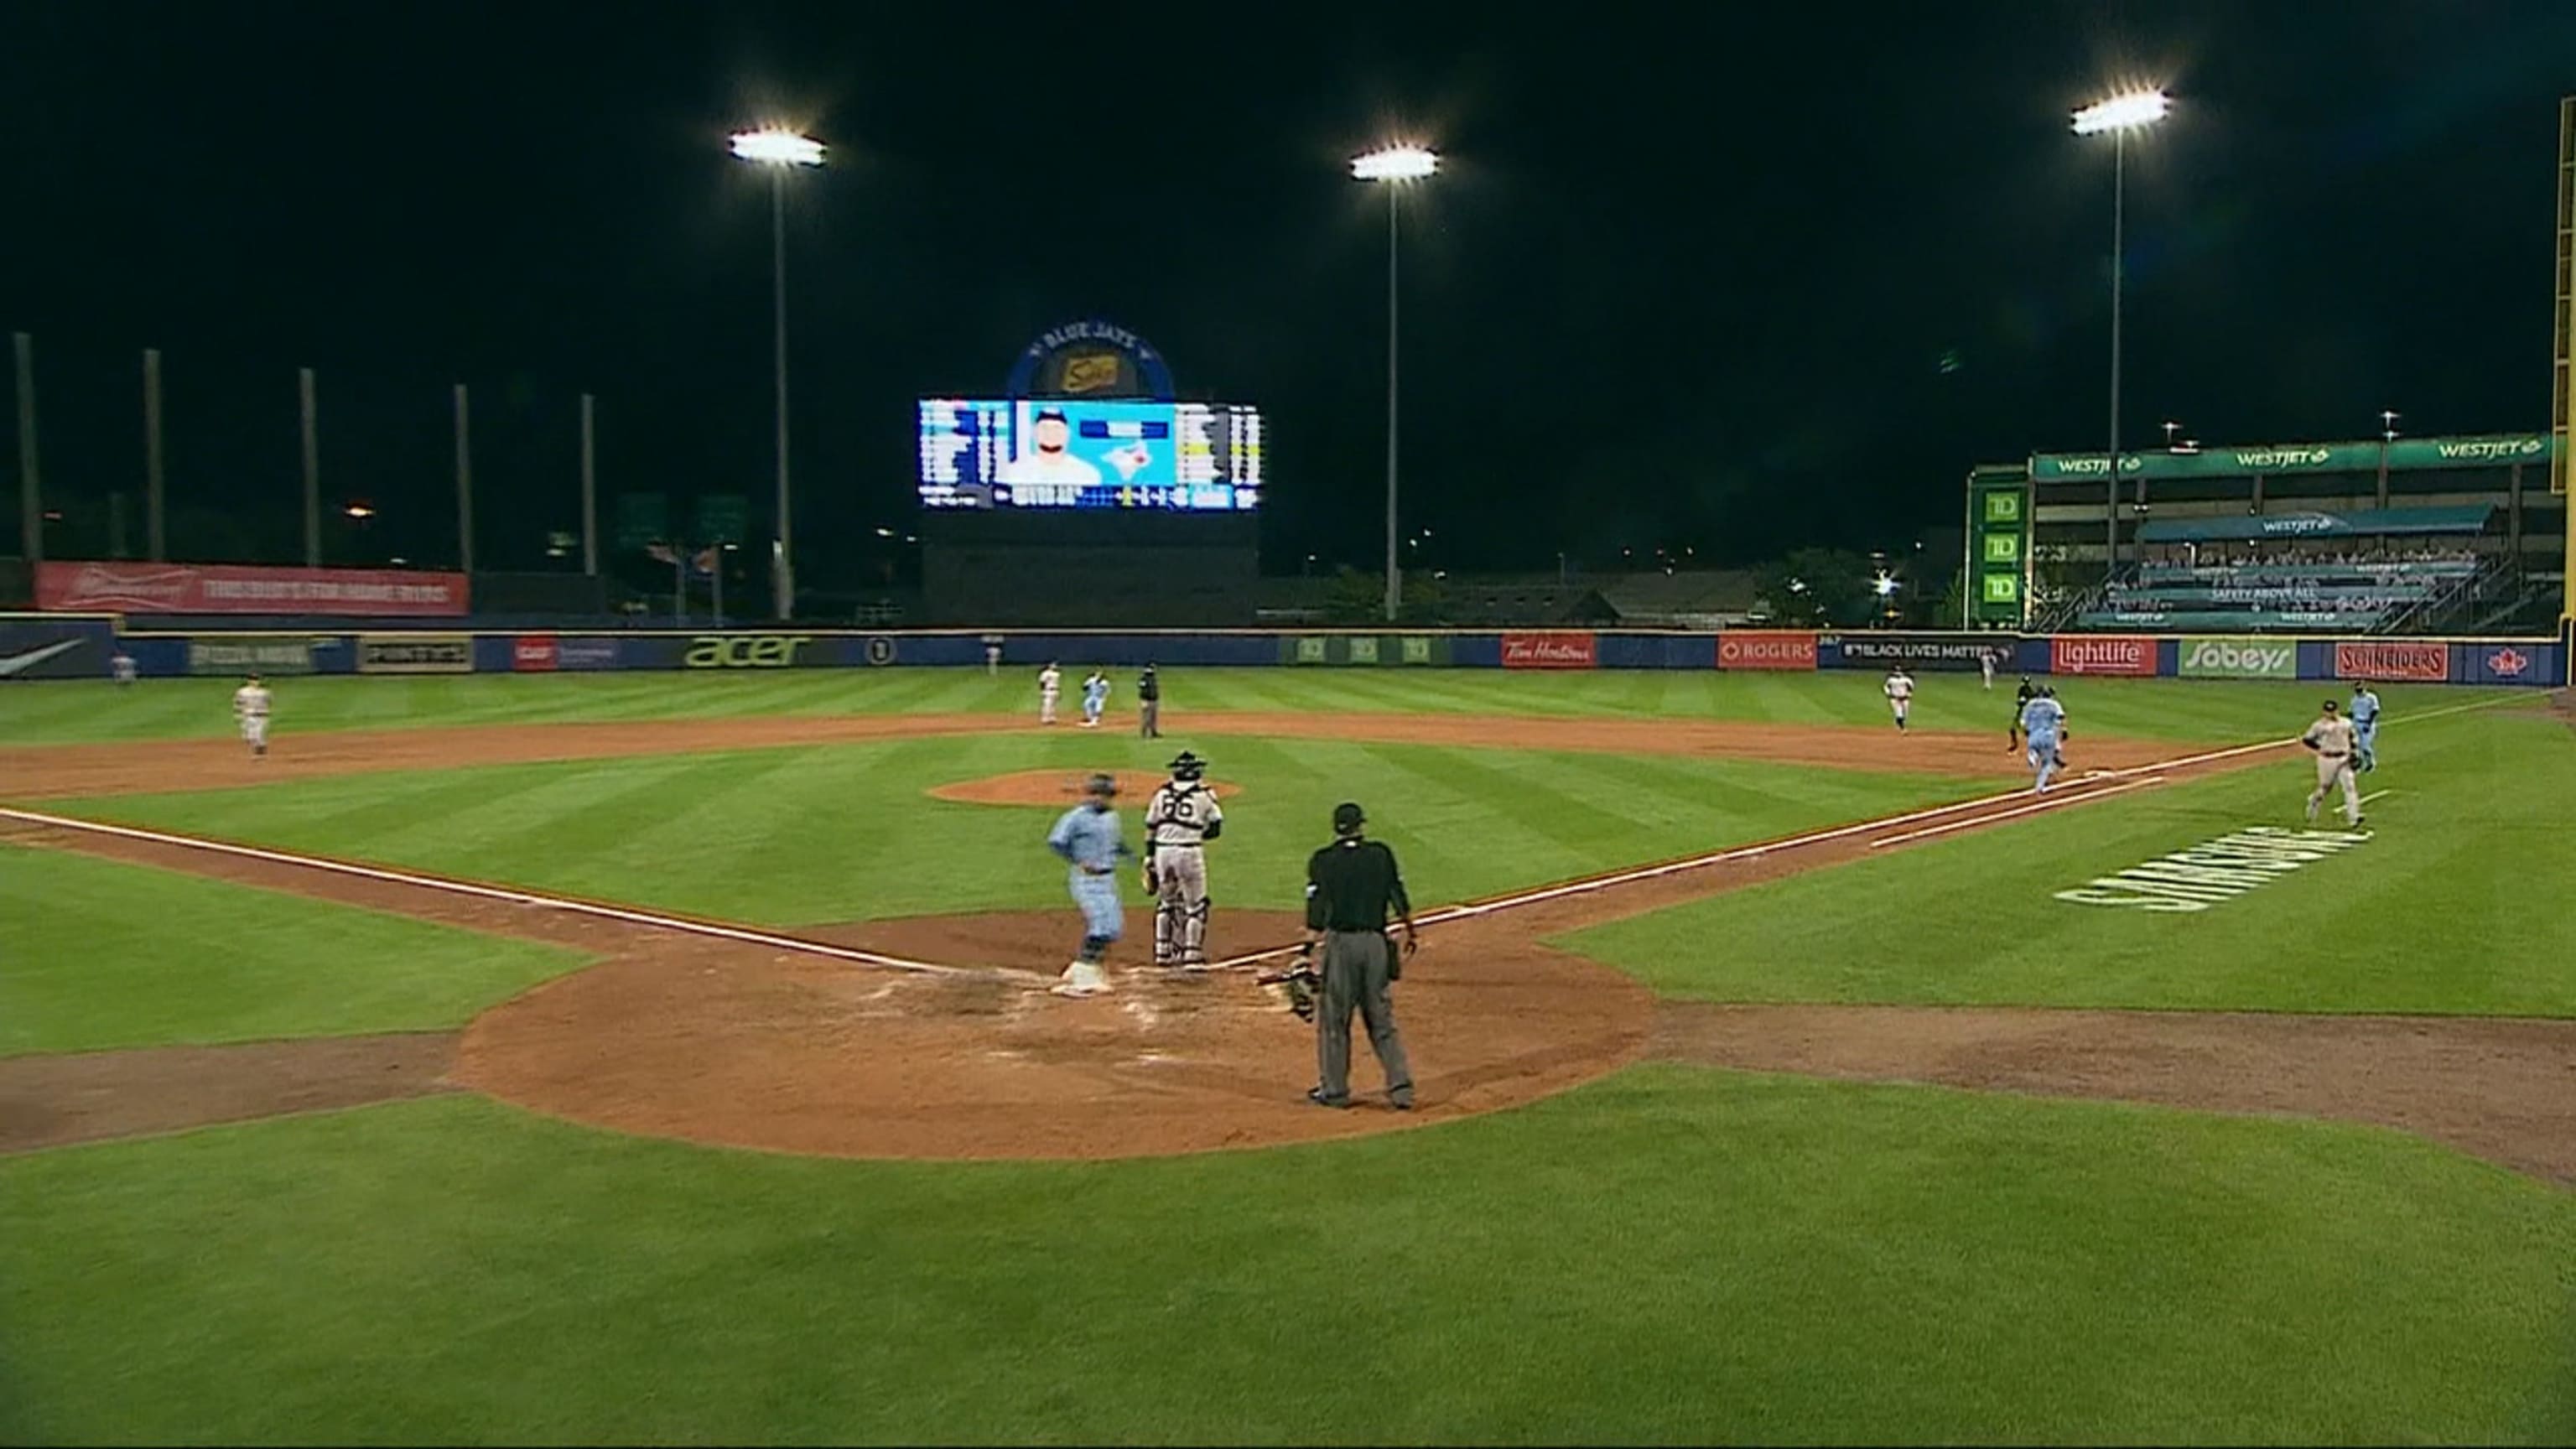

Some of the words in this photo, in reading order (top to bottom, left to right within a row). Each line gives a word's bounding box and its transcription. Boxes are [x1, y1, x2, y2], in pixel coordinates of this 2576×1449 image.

[1044, 322, 1090, 349] BLUE
[1092, 322, 1136, 349] JAYS
[2236, 450, 2309, 467] WESTJET
[2439, 441, 2520, 460] WESTJET
[1988, 496, 2016, 514] TD
[2264, 519, 2319, 534] WESTJET
[1988, 539, 2014, 557] TD
[1987, 578, 2013, 596] TD
[2212, 589, 2251, 600] SAFETY
[2253, 589, 2293, 600] ABOVE
[2295, 589, 2316, 599] ALL
[685, 637, 812, 667] acer
[1506, 641, 1533, 659] Tim
[1533, 641, 1590, 660] Hortons
[1742, 643, 1813, 659] ROGERS
[1863, 644, 1902, 657] BLACK
[1904, 644, 1940, 657] LIVES
[2184, 641, 2290, 673] Sobeys
